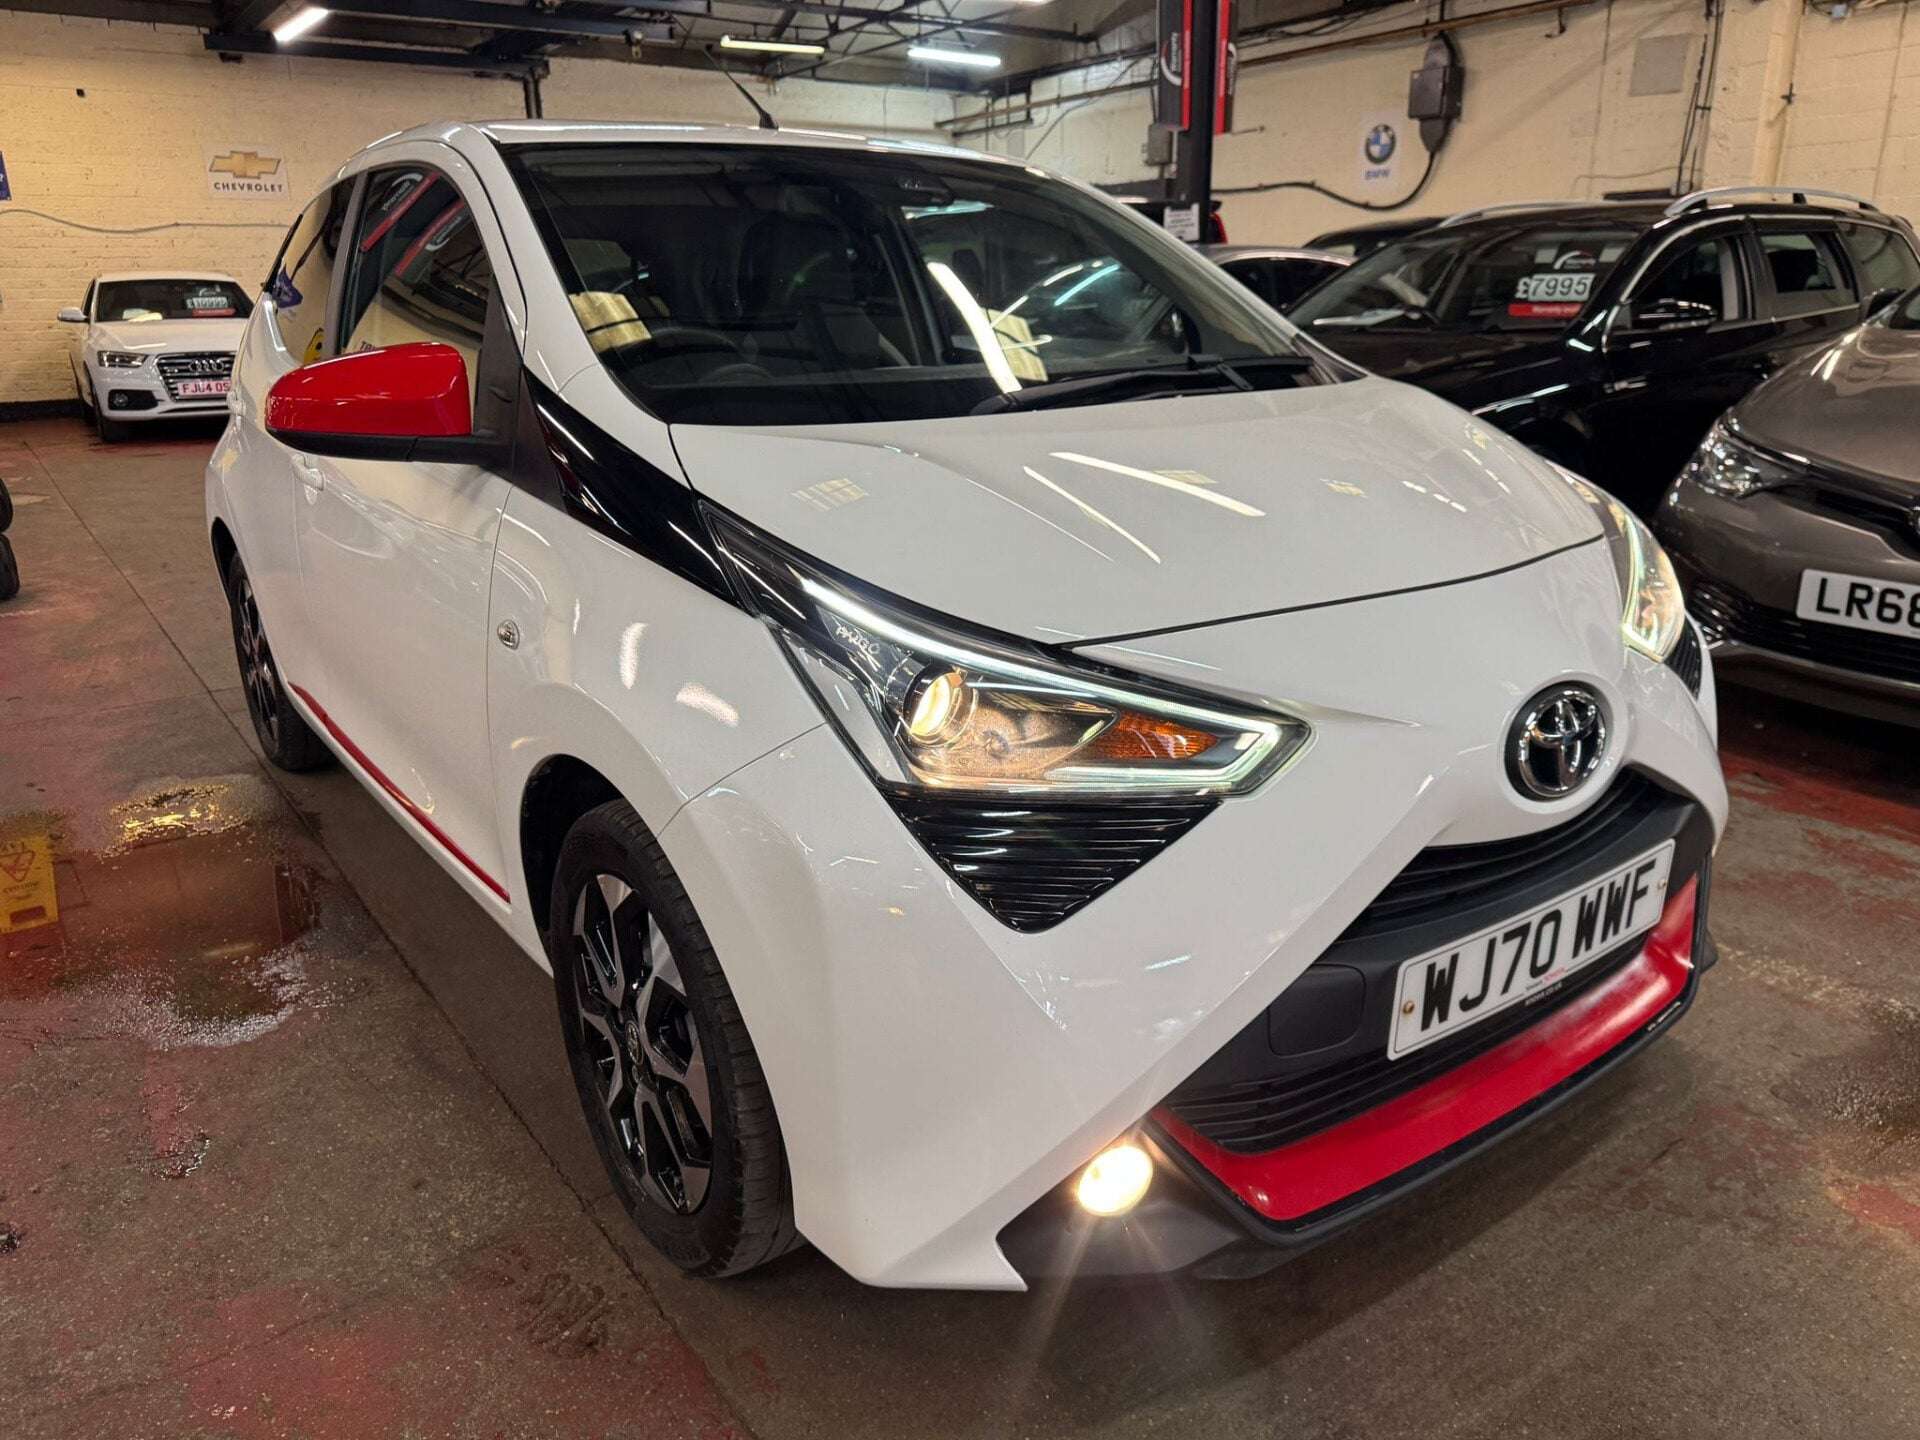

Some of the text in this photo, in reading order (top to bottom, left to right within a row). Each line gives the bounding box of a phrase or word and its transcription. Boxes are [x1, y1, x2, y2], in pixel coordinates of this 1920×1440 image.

[214, 182, 283, 192] CHEVROLET
[1515, 276, 1589, 298] £7995
[1421, 859, 1656, 1031] WJ70 WWF
